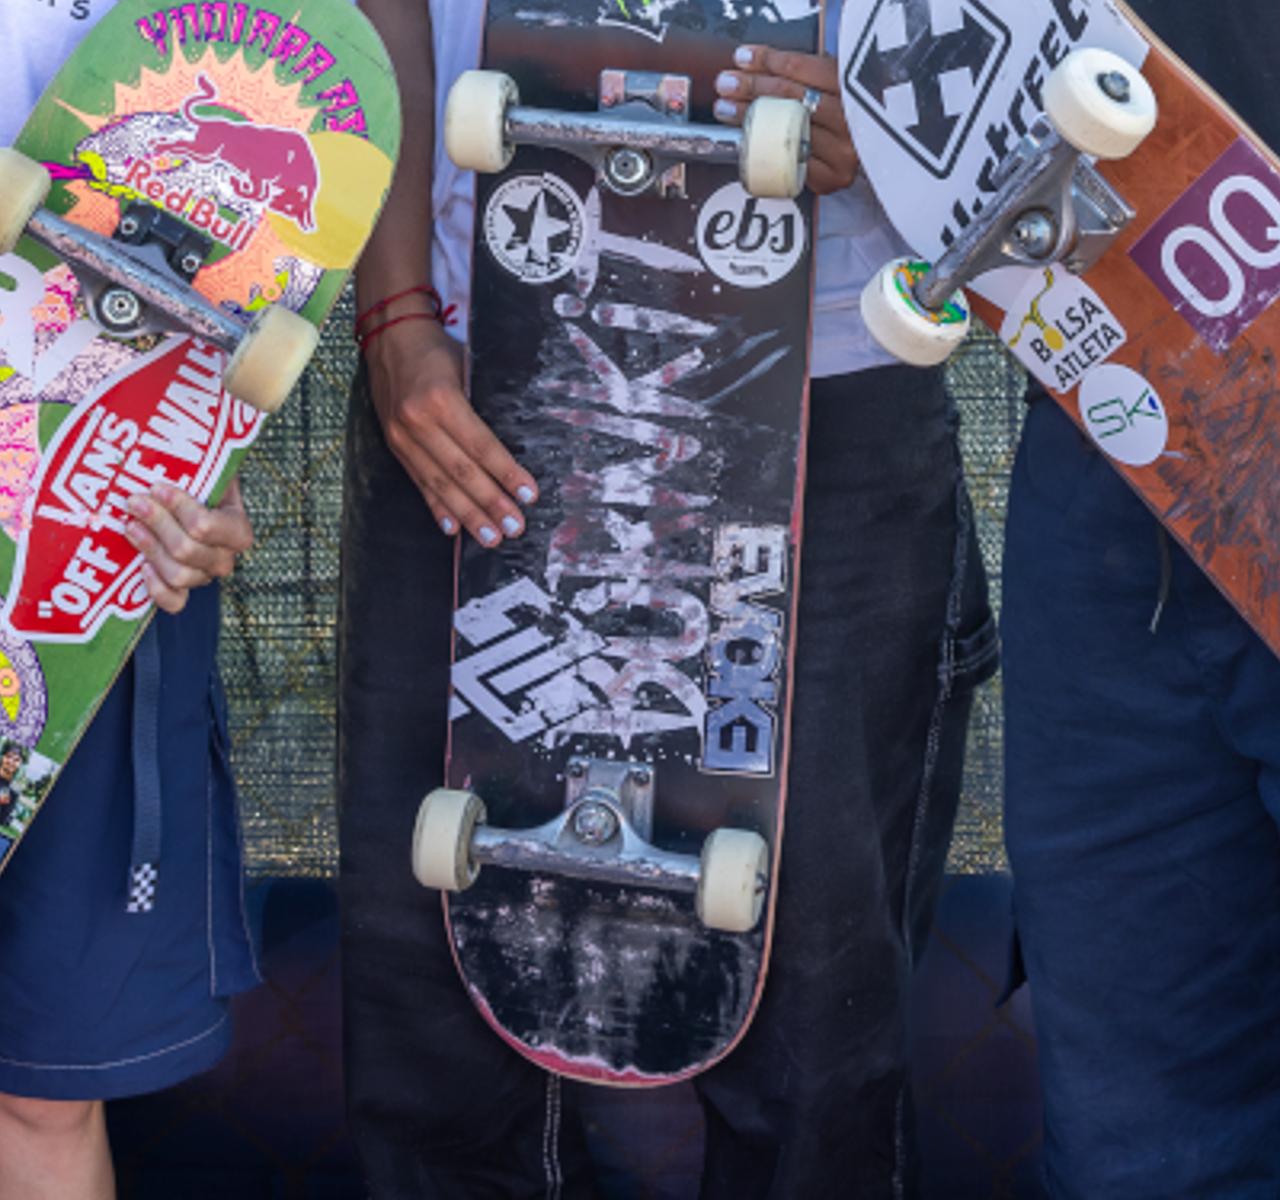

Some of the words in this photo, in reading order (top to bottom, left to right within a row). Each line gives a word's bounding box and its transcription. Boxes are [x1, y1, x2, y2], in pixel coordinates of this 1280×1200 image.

[125, 159, 193, 214] Red
[188, 196, 256, 250] Bull
[703, 197, 795, 254] ebs
[1029, 296, 1106, 365] BOLSA
[1052, 321, 1124, 390] ATLETA
[36, 404, 140, 526] VANS
[700, 522, 790, 776] EVOKE
